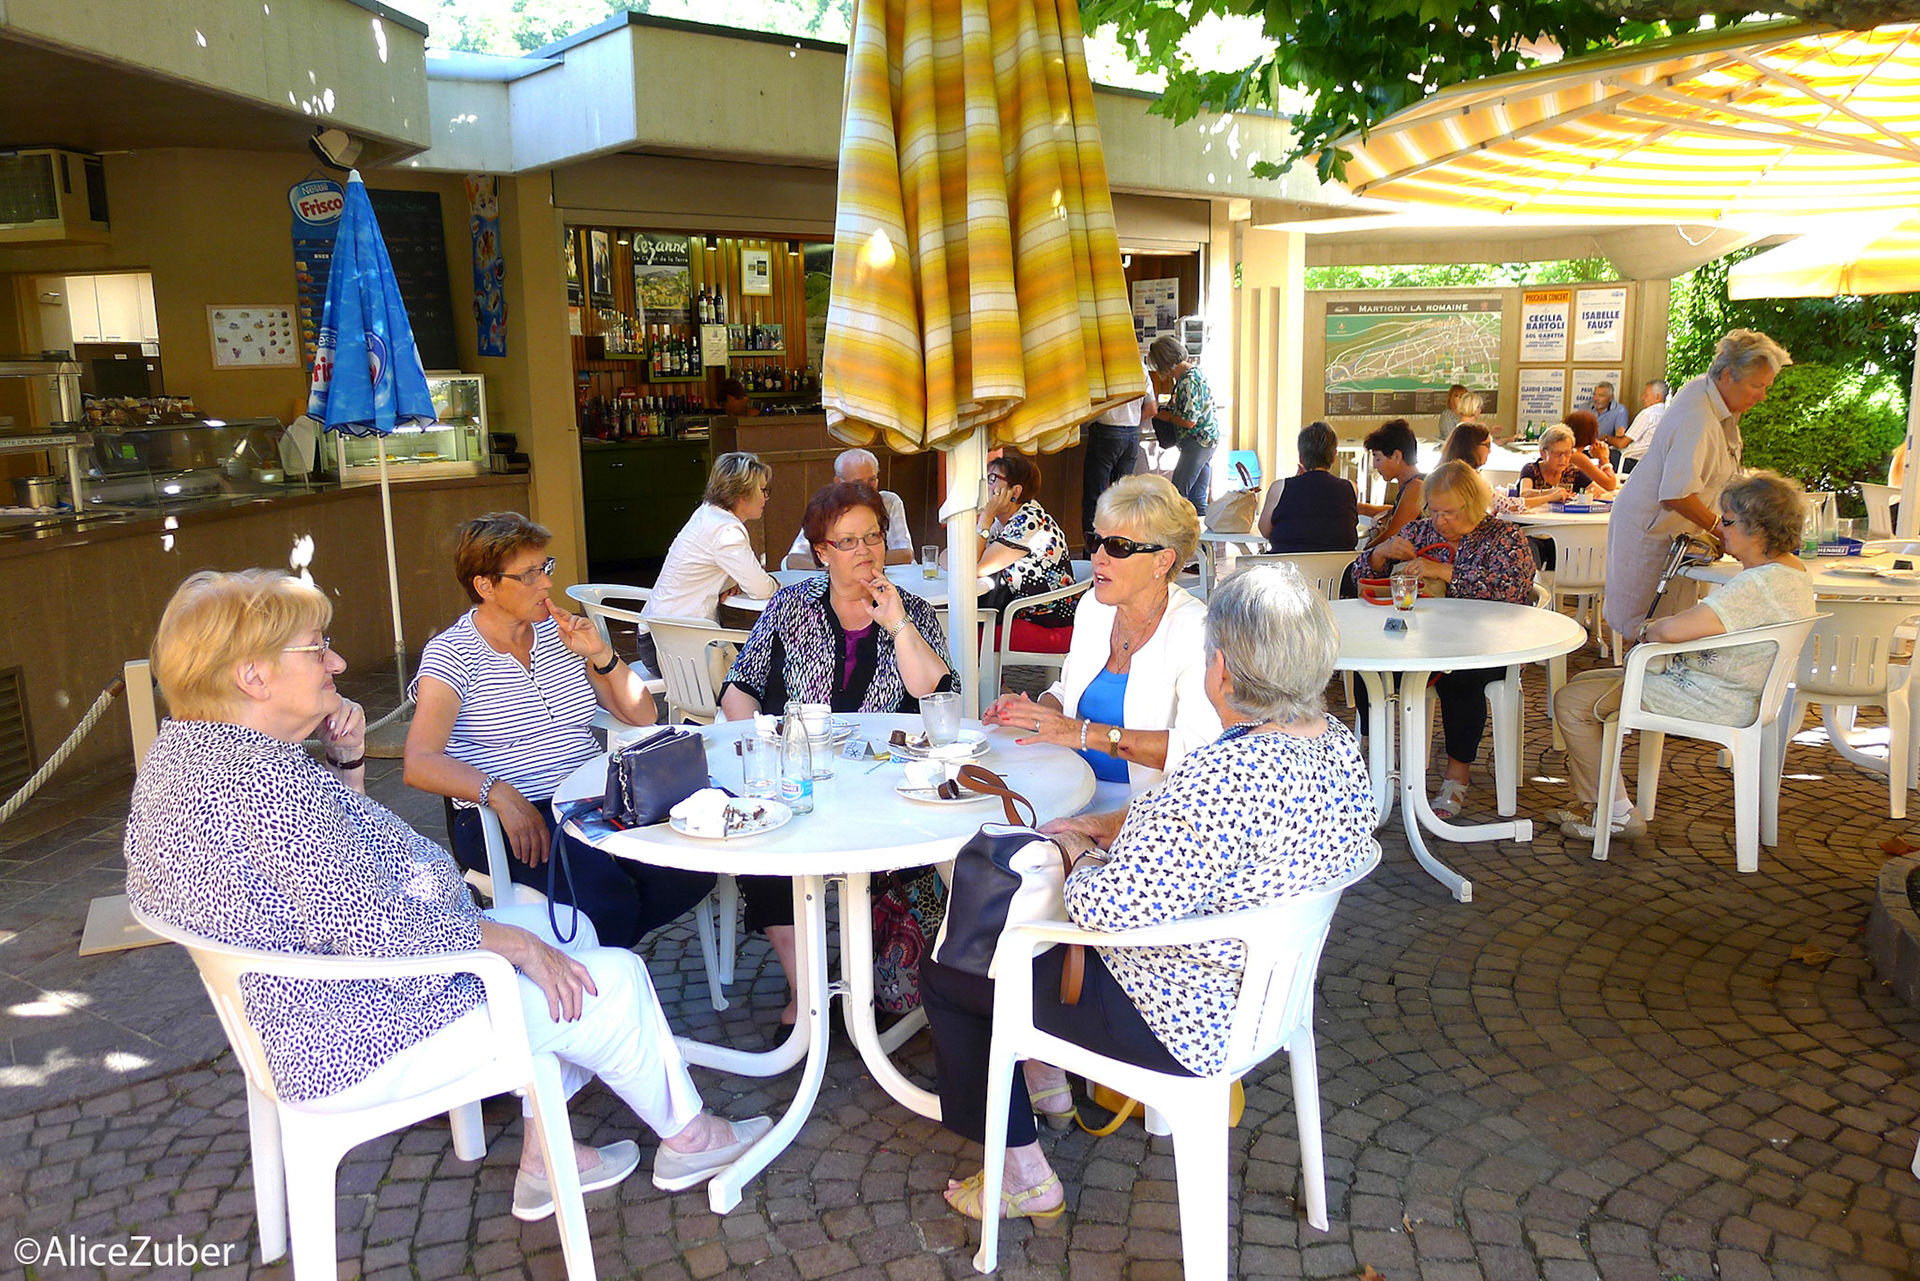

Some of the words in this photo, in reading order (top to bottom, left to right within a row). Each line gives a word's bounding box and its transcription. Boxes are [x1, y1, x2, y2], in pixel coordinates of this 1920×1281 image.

[299, 198, 343, 217] Frisco
[633, 234, 688, 266] Cezanne
[1548, 292, 1569, 301] CONCERT
[1358, 305, 1407, 313] MARTIGNY
[1410, 304, 1422, 312] LA
[1425, 303, 1469, 311] ROMAINE
[1529, 314, 1563, 322] CECILIA
[1582, 310, 1620, 320] ISABELLE
[1526, 322, 1565, 330] BARTOLI
[1587, 320, 1614, 330] FAUST
